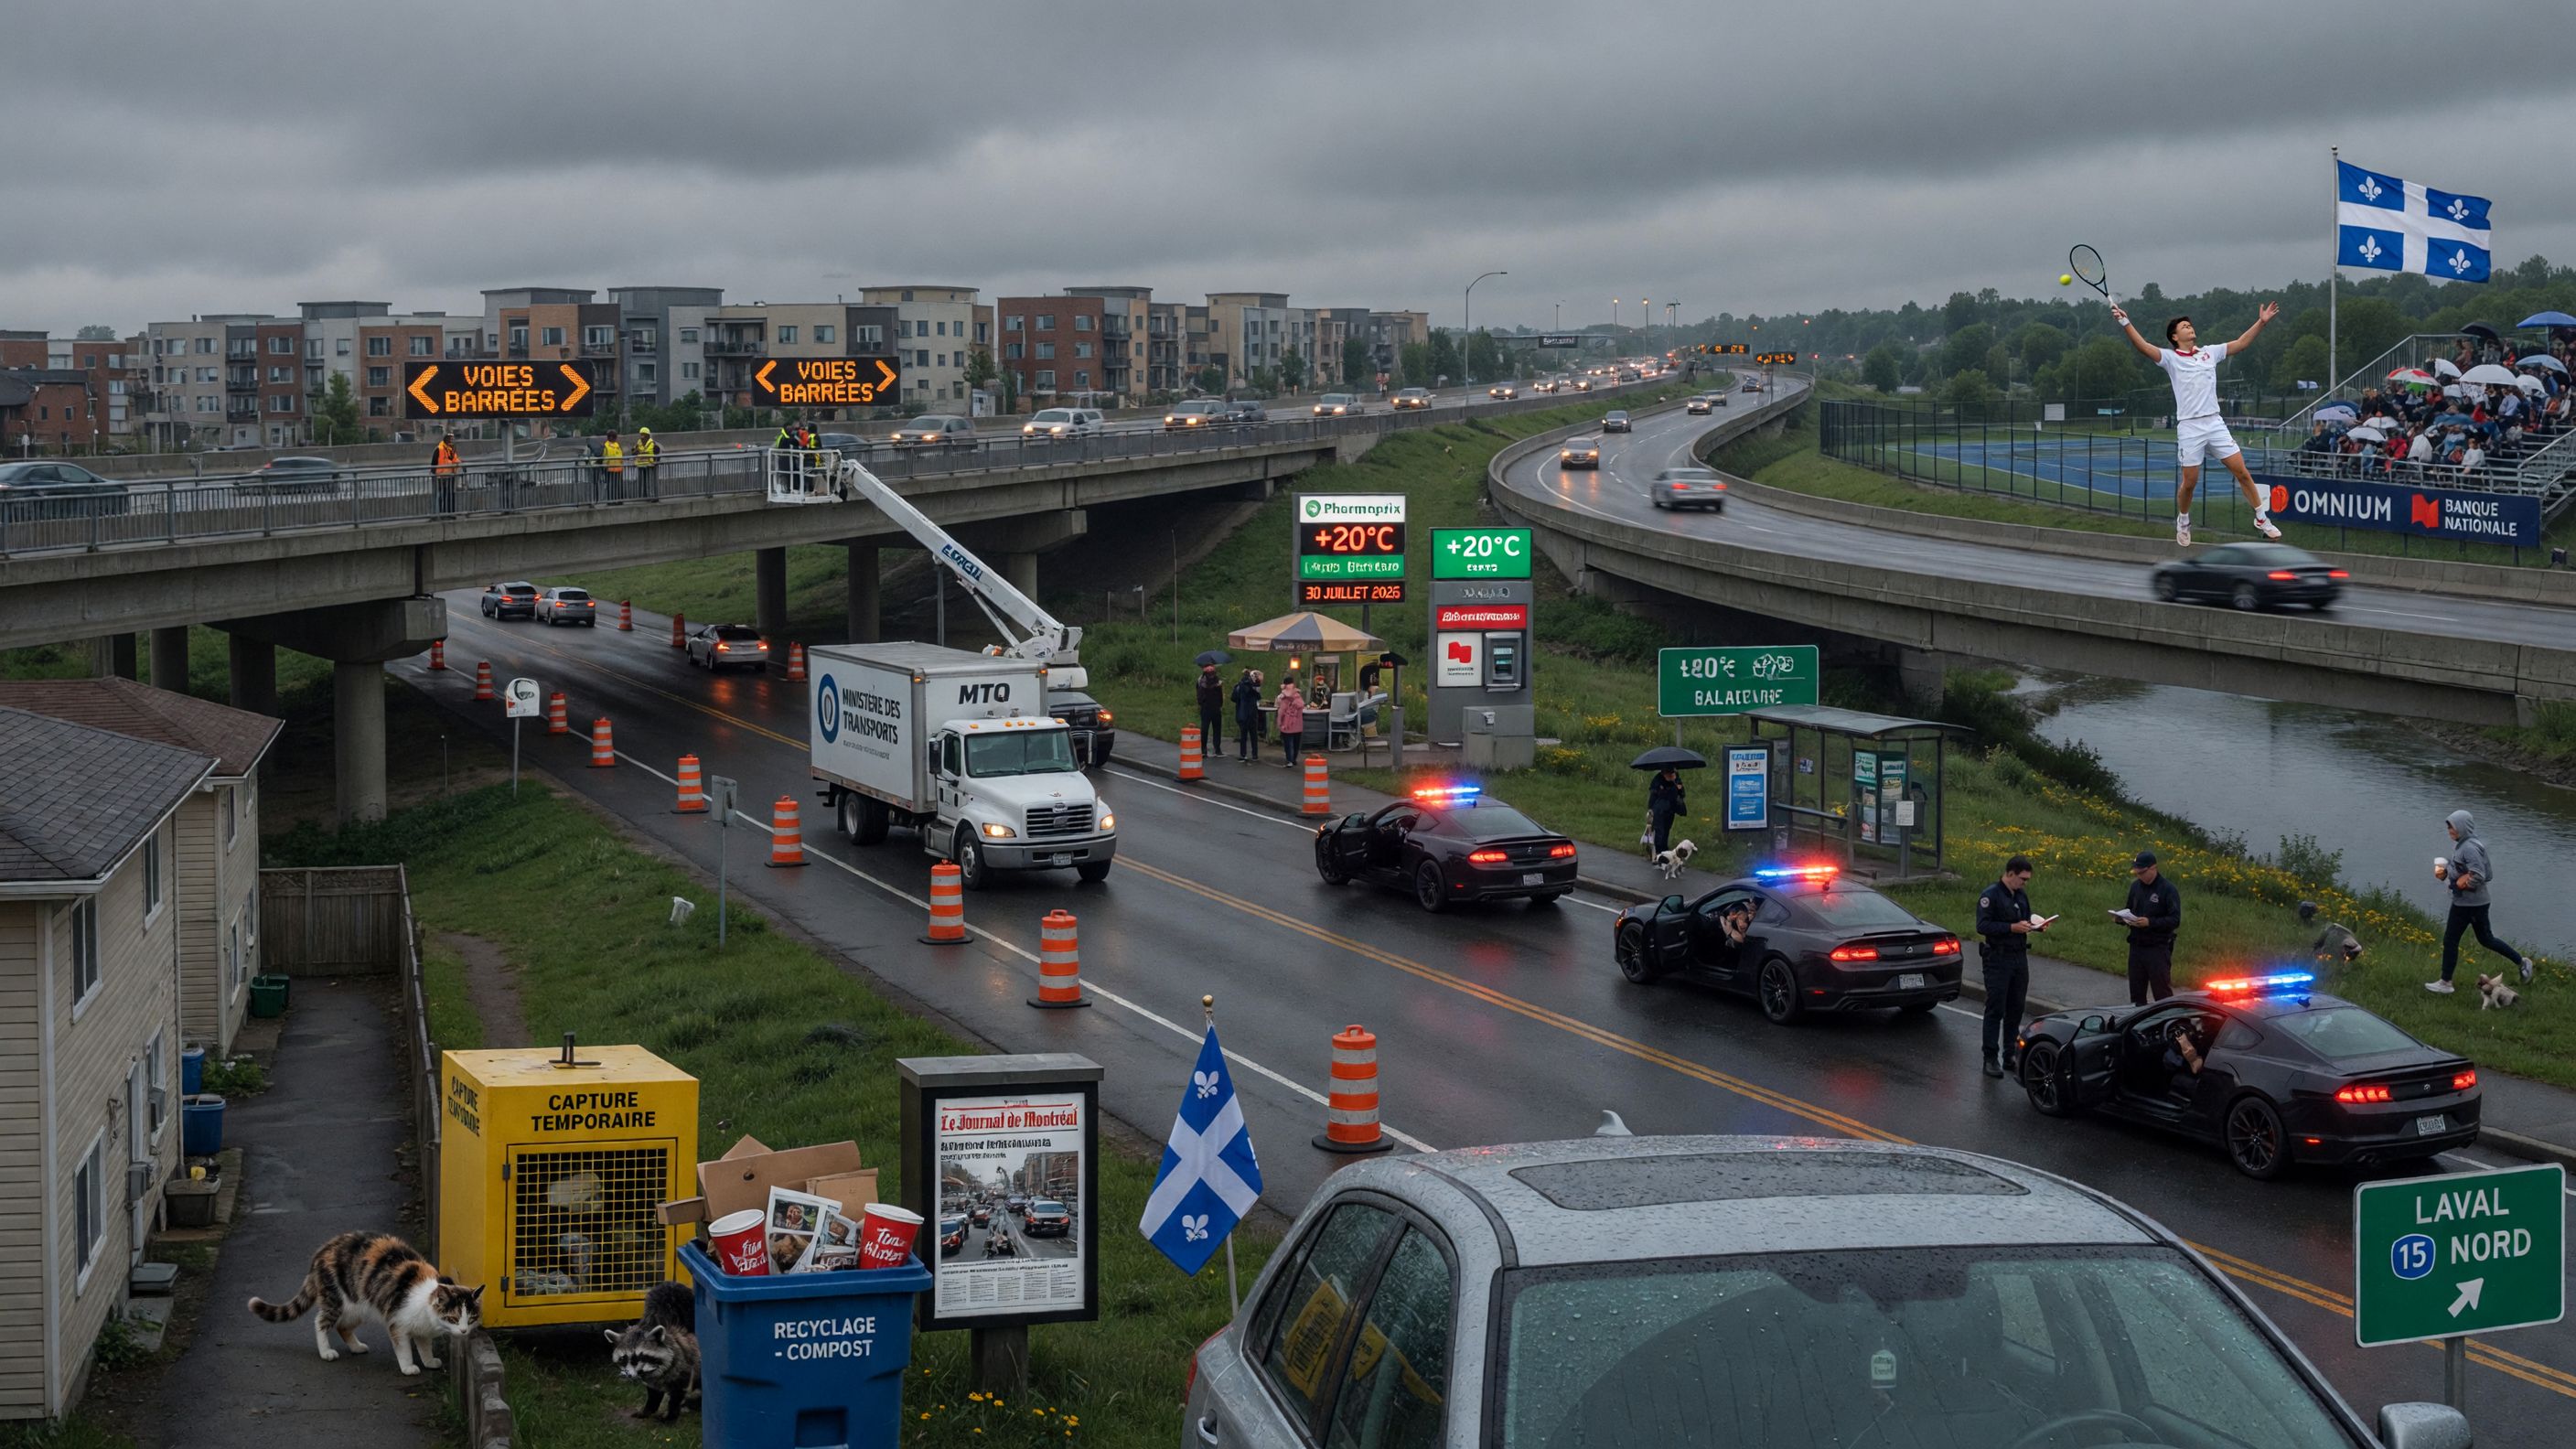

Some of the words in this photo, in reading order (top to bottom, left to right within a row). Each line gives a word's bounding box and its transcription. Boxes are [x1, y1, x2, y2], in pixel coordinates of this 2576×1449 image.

[464, 365, 533, 387] VOIES
[798, 360, 855, 381] VOIES
[445, 386, 555, 413] BARRÉES
[779, 380, 874, 402] BARRÉES
[2294, 489, 2391, 522] OMNIUM
[2444, 499, 2499, 517] BANQUE
[2444, 516, 2518, 537] NATIONALE
[1315, 526, 1394, 552] +20°C
[1446, 535, 1520, 557] +20°C
[1305, 586, 1321, 600] 30
[1323, 585, 1368, 600] JUILLET
[958, 682, 1011, 705] MTQ
[885, 698, 901, 719] DES
[843, 711, 898, 745] TRANSPORTS
[548, 1091, 639, 1111] CAPTURE
[531, 1111, 656, 1132] TEMPORAIRE
[941, 1115, 955, 1132] Le
[957, 1111, 1004, 1131] Journal
[1007, 1112, 1022, 1128] de
[1024, 1107, 1078, 1128] Montréal
[2415, 1187, 2510, 1224] LAVAL
[2399, 1241, 2427, 1270] 15
[2450, 1229, 2532, 1265] NORD
[774, 1316, 875, 1339] RECYCLAGE
[787, 1339, 874, 1360] COMPOST
